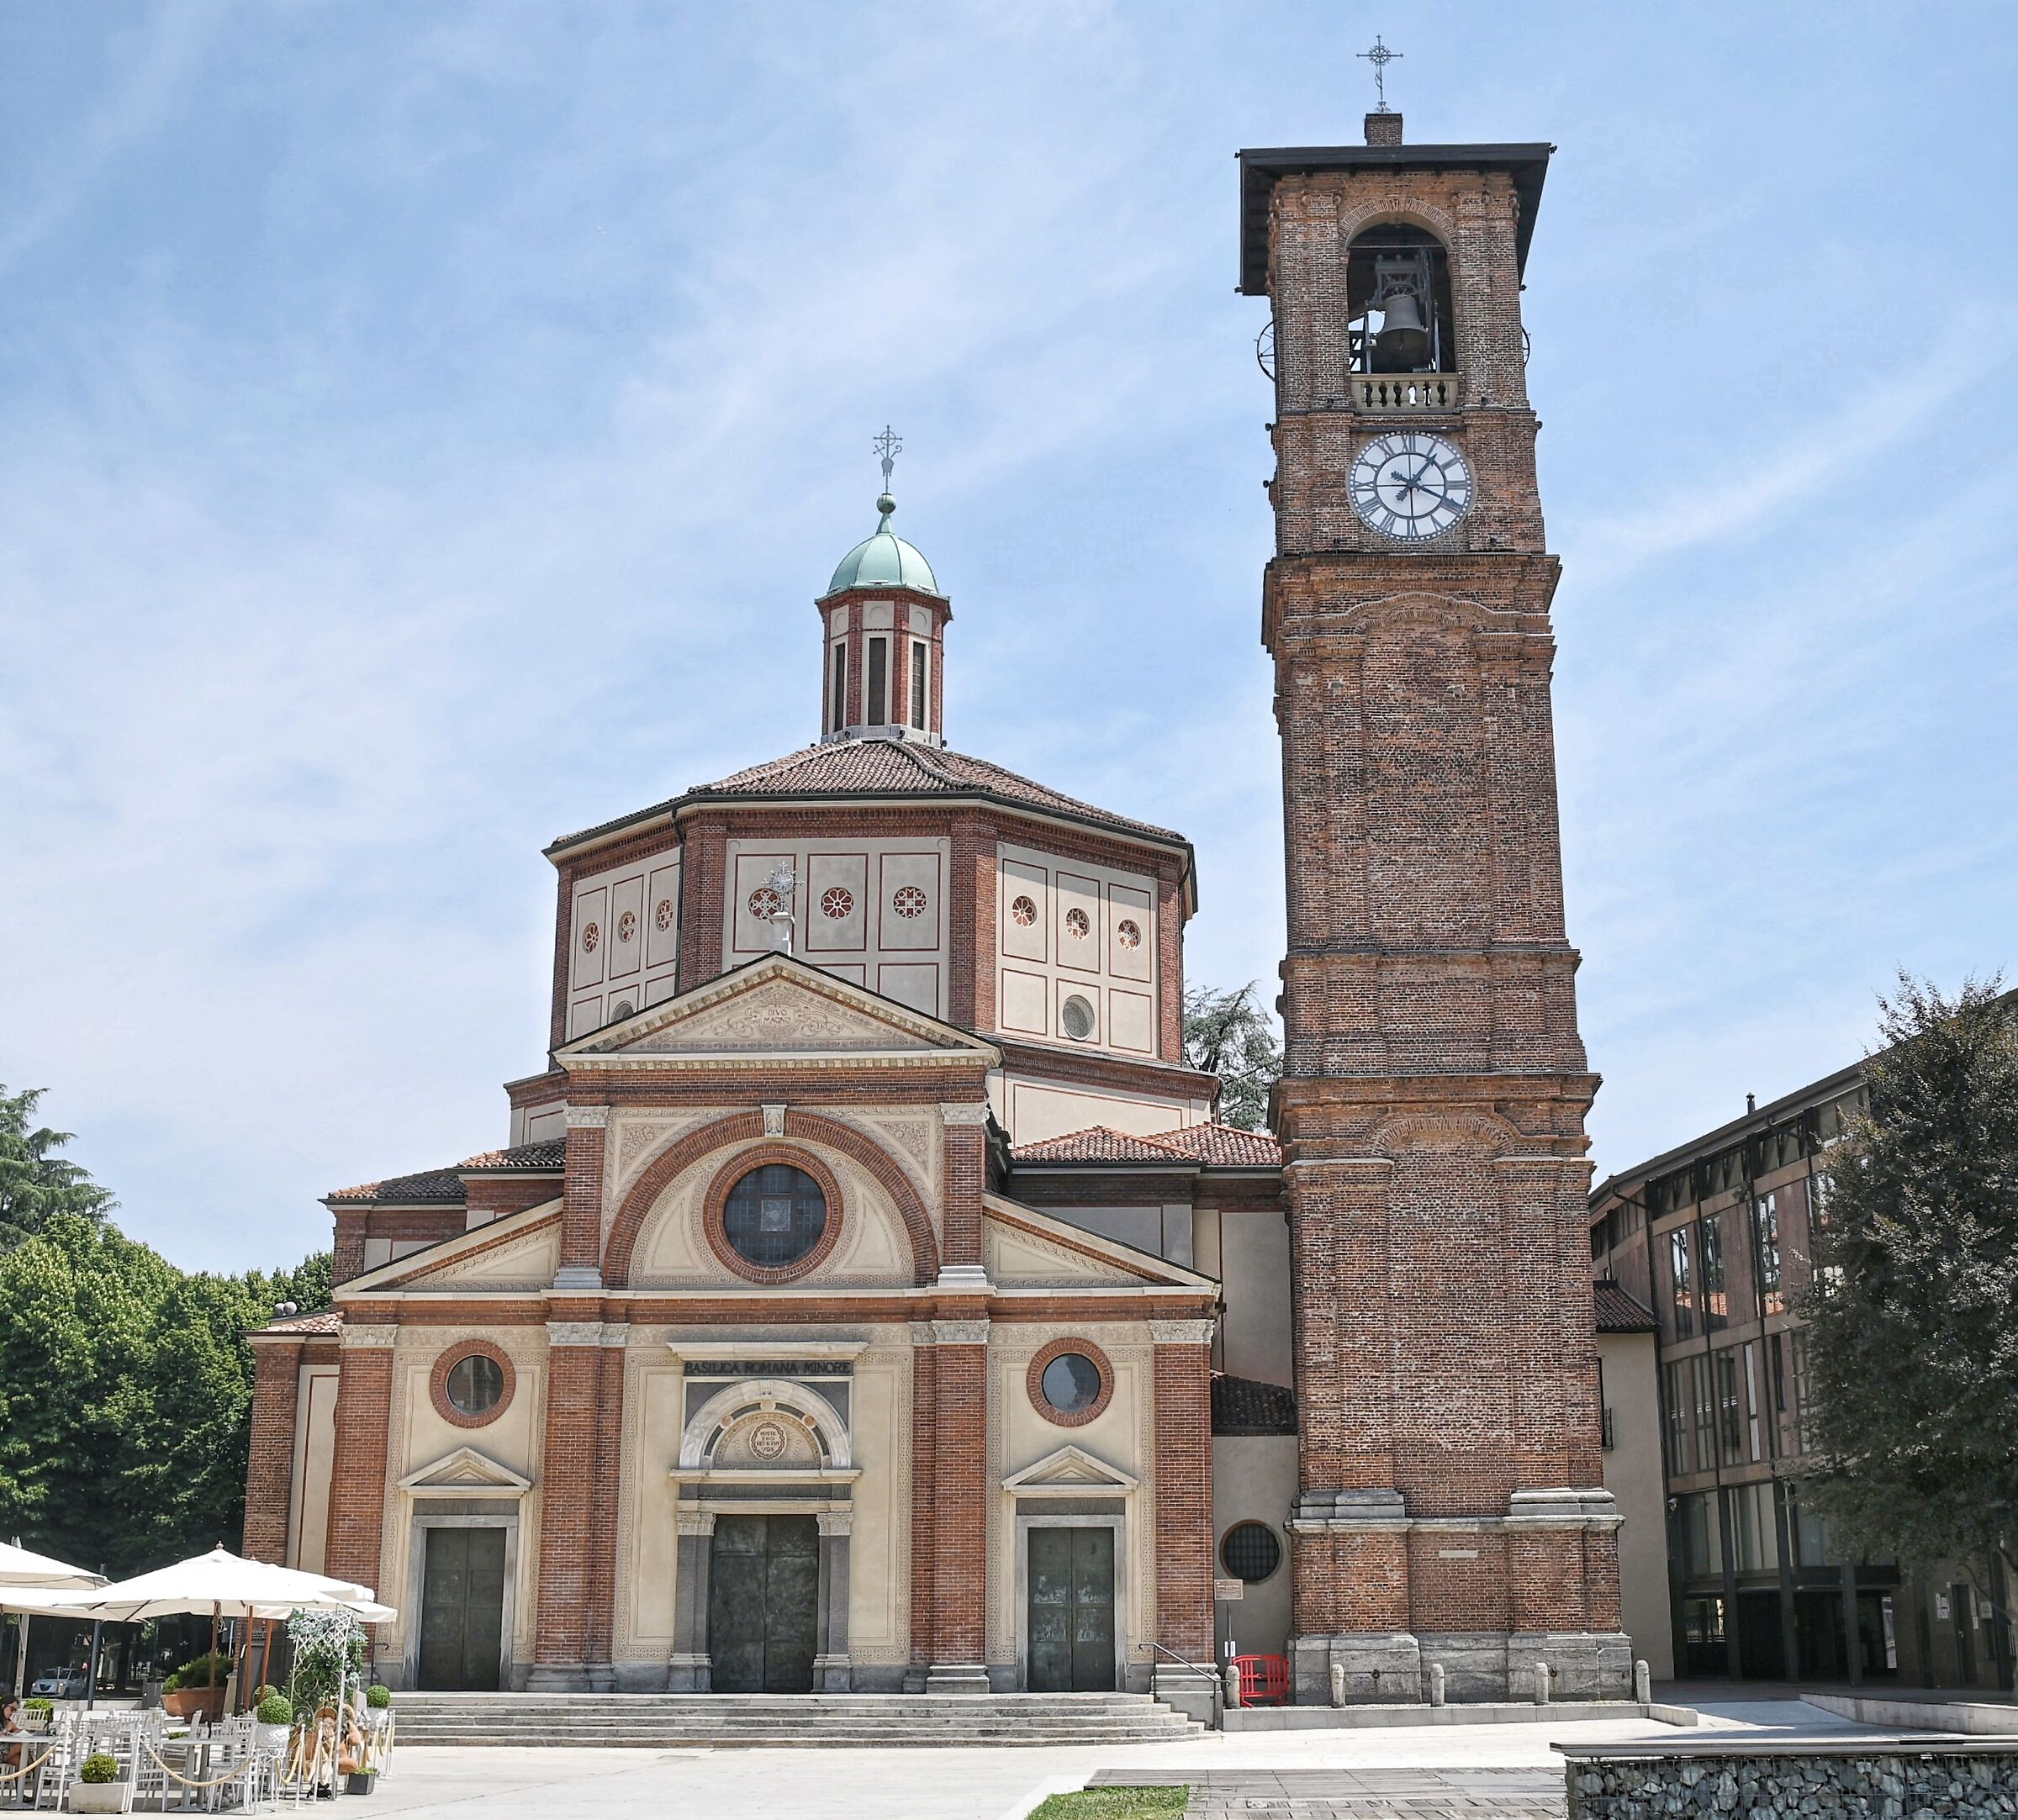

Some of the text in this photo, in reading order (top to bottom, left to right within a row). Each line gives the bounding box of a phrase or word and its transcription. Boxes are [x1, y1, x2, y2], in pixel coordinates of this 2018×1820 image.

[685, 1362, 851, 1374] BASILICA ROMANA MINORE
